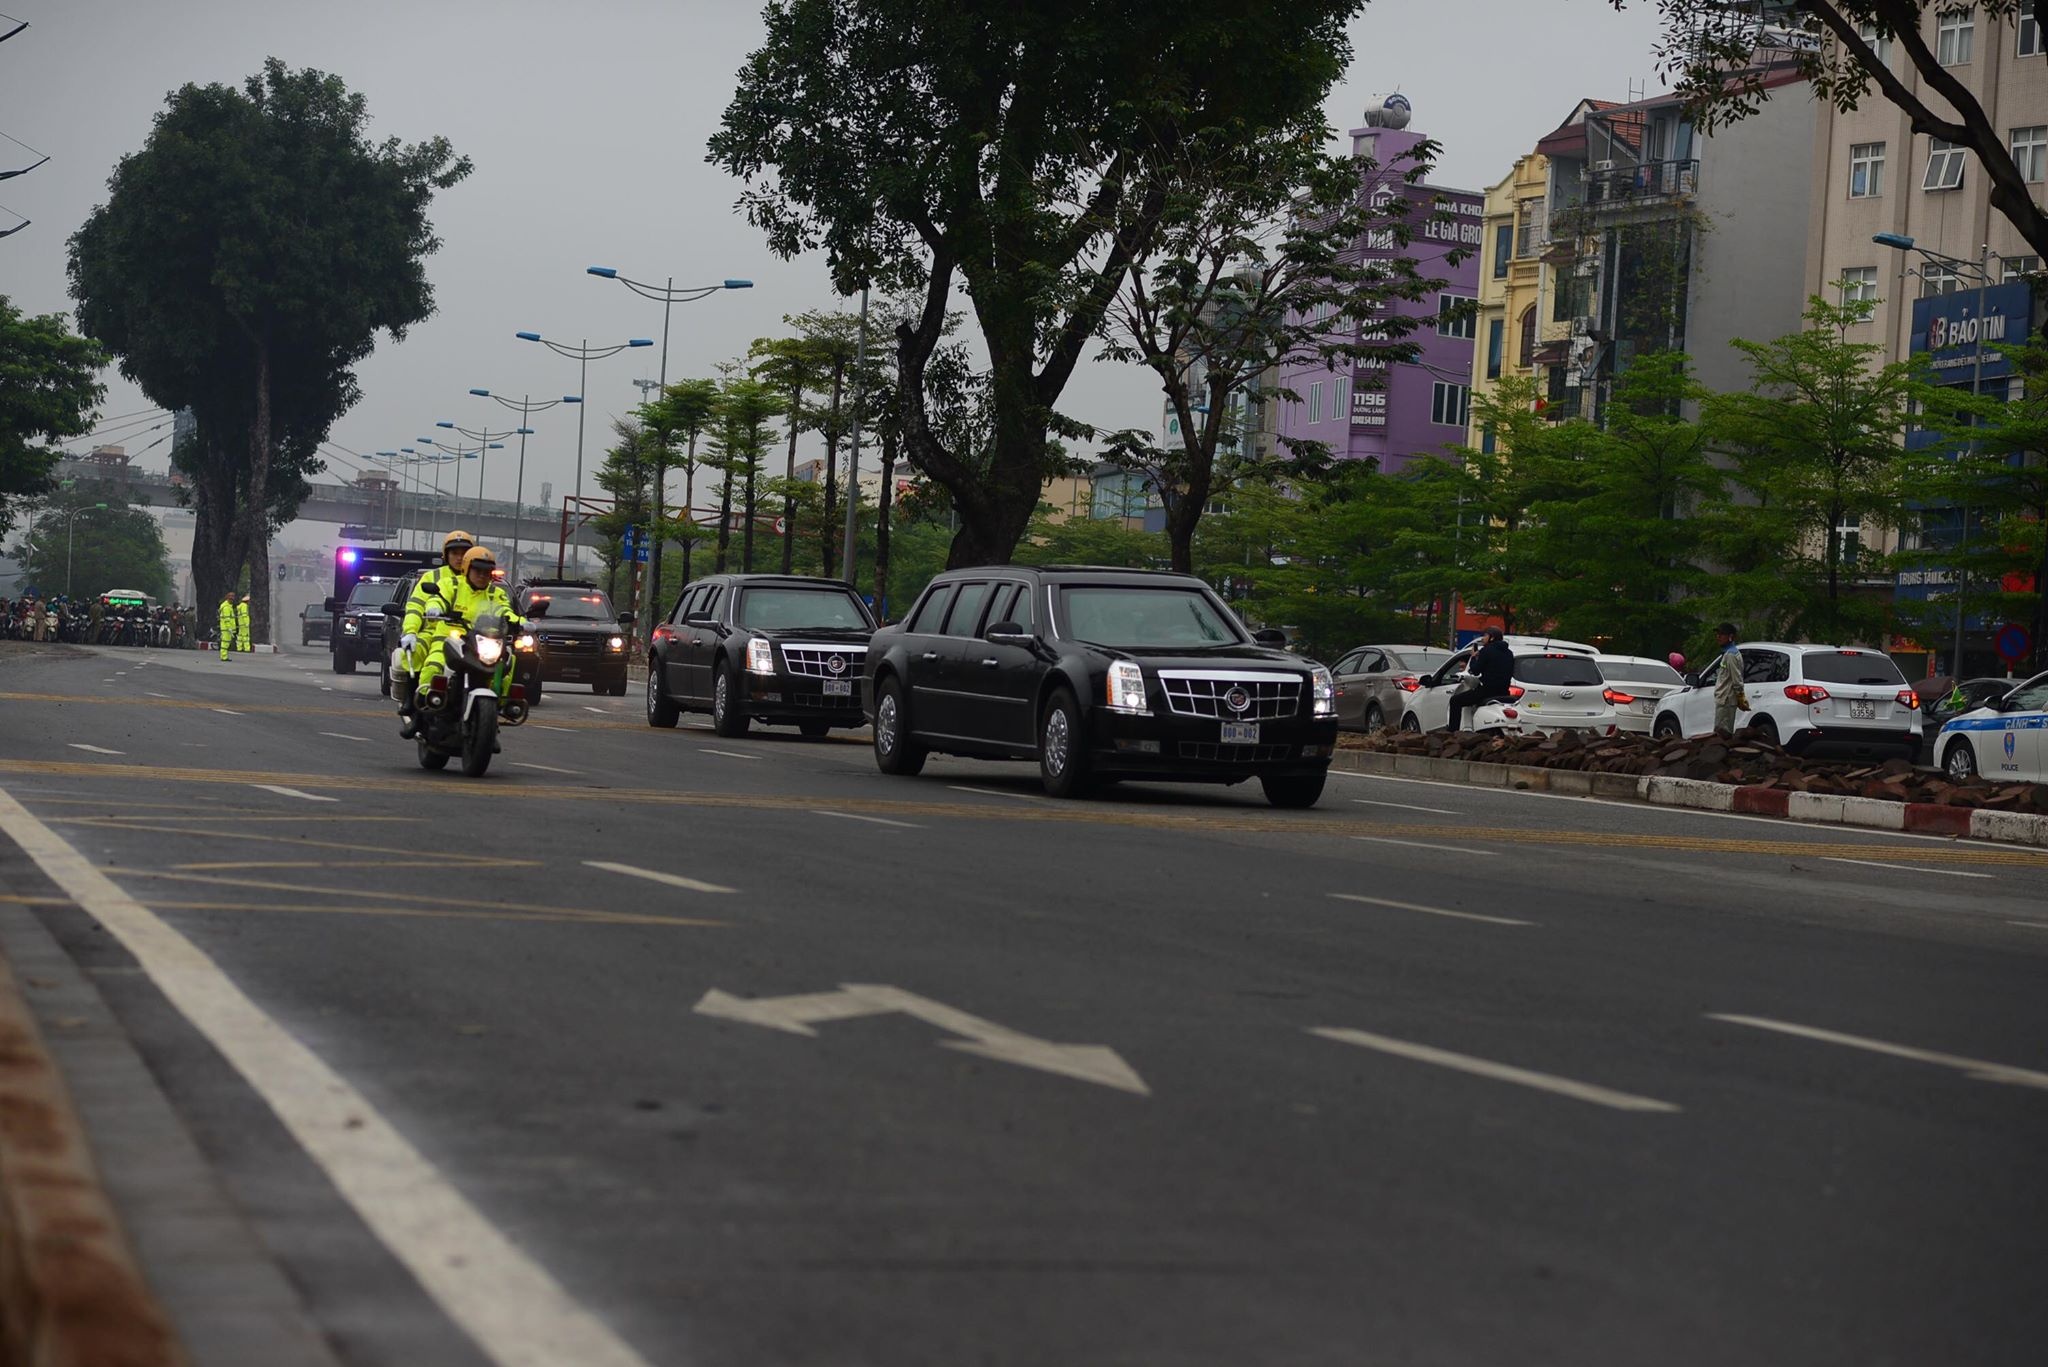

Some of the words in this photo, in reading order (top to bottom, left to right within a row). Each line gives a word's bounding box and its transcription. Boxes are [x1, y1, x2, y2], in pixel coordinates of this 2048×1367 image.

[1948, 308, 1978, 345] BẢO
[1982, 306, 2006, 340] TÍN
[1353, 393, 1386, 406] 1196
[2001, 763, 2018, 772] POLICE
